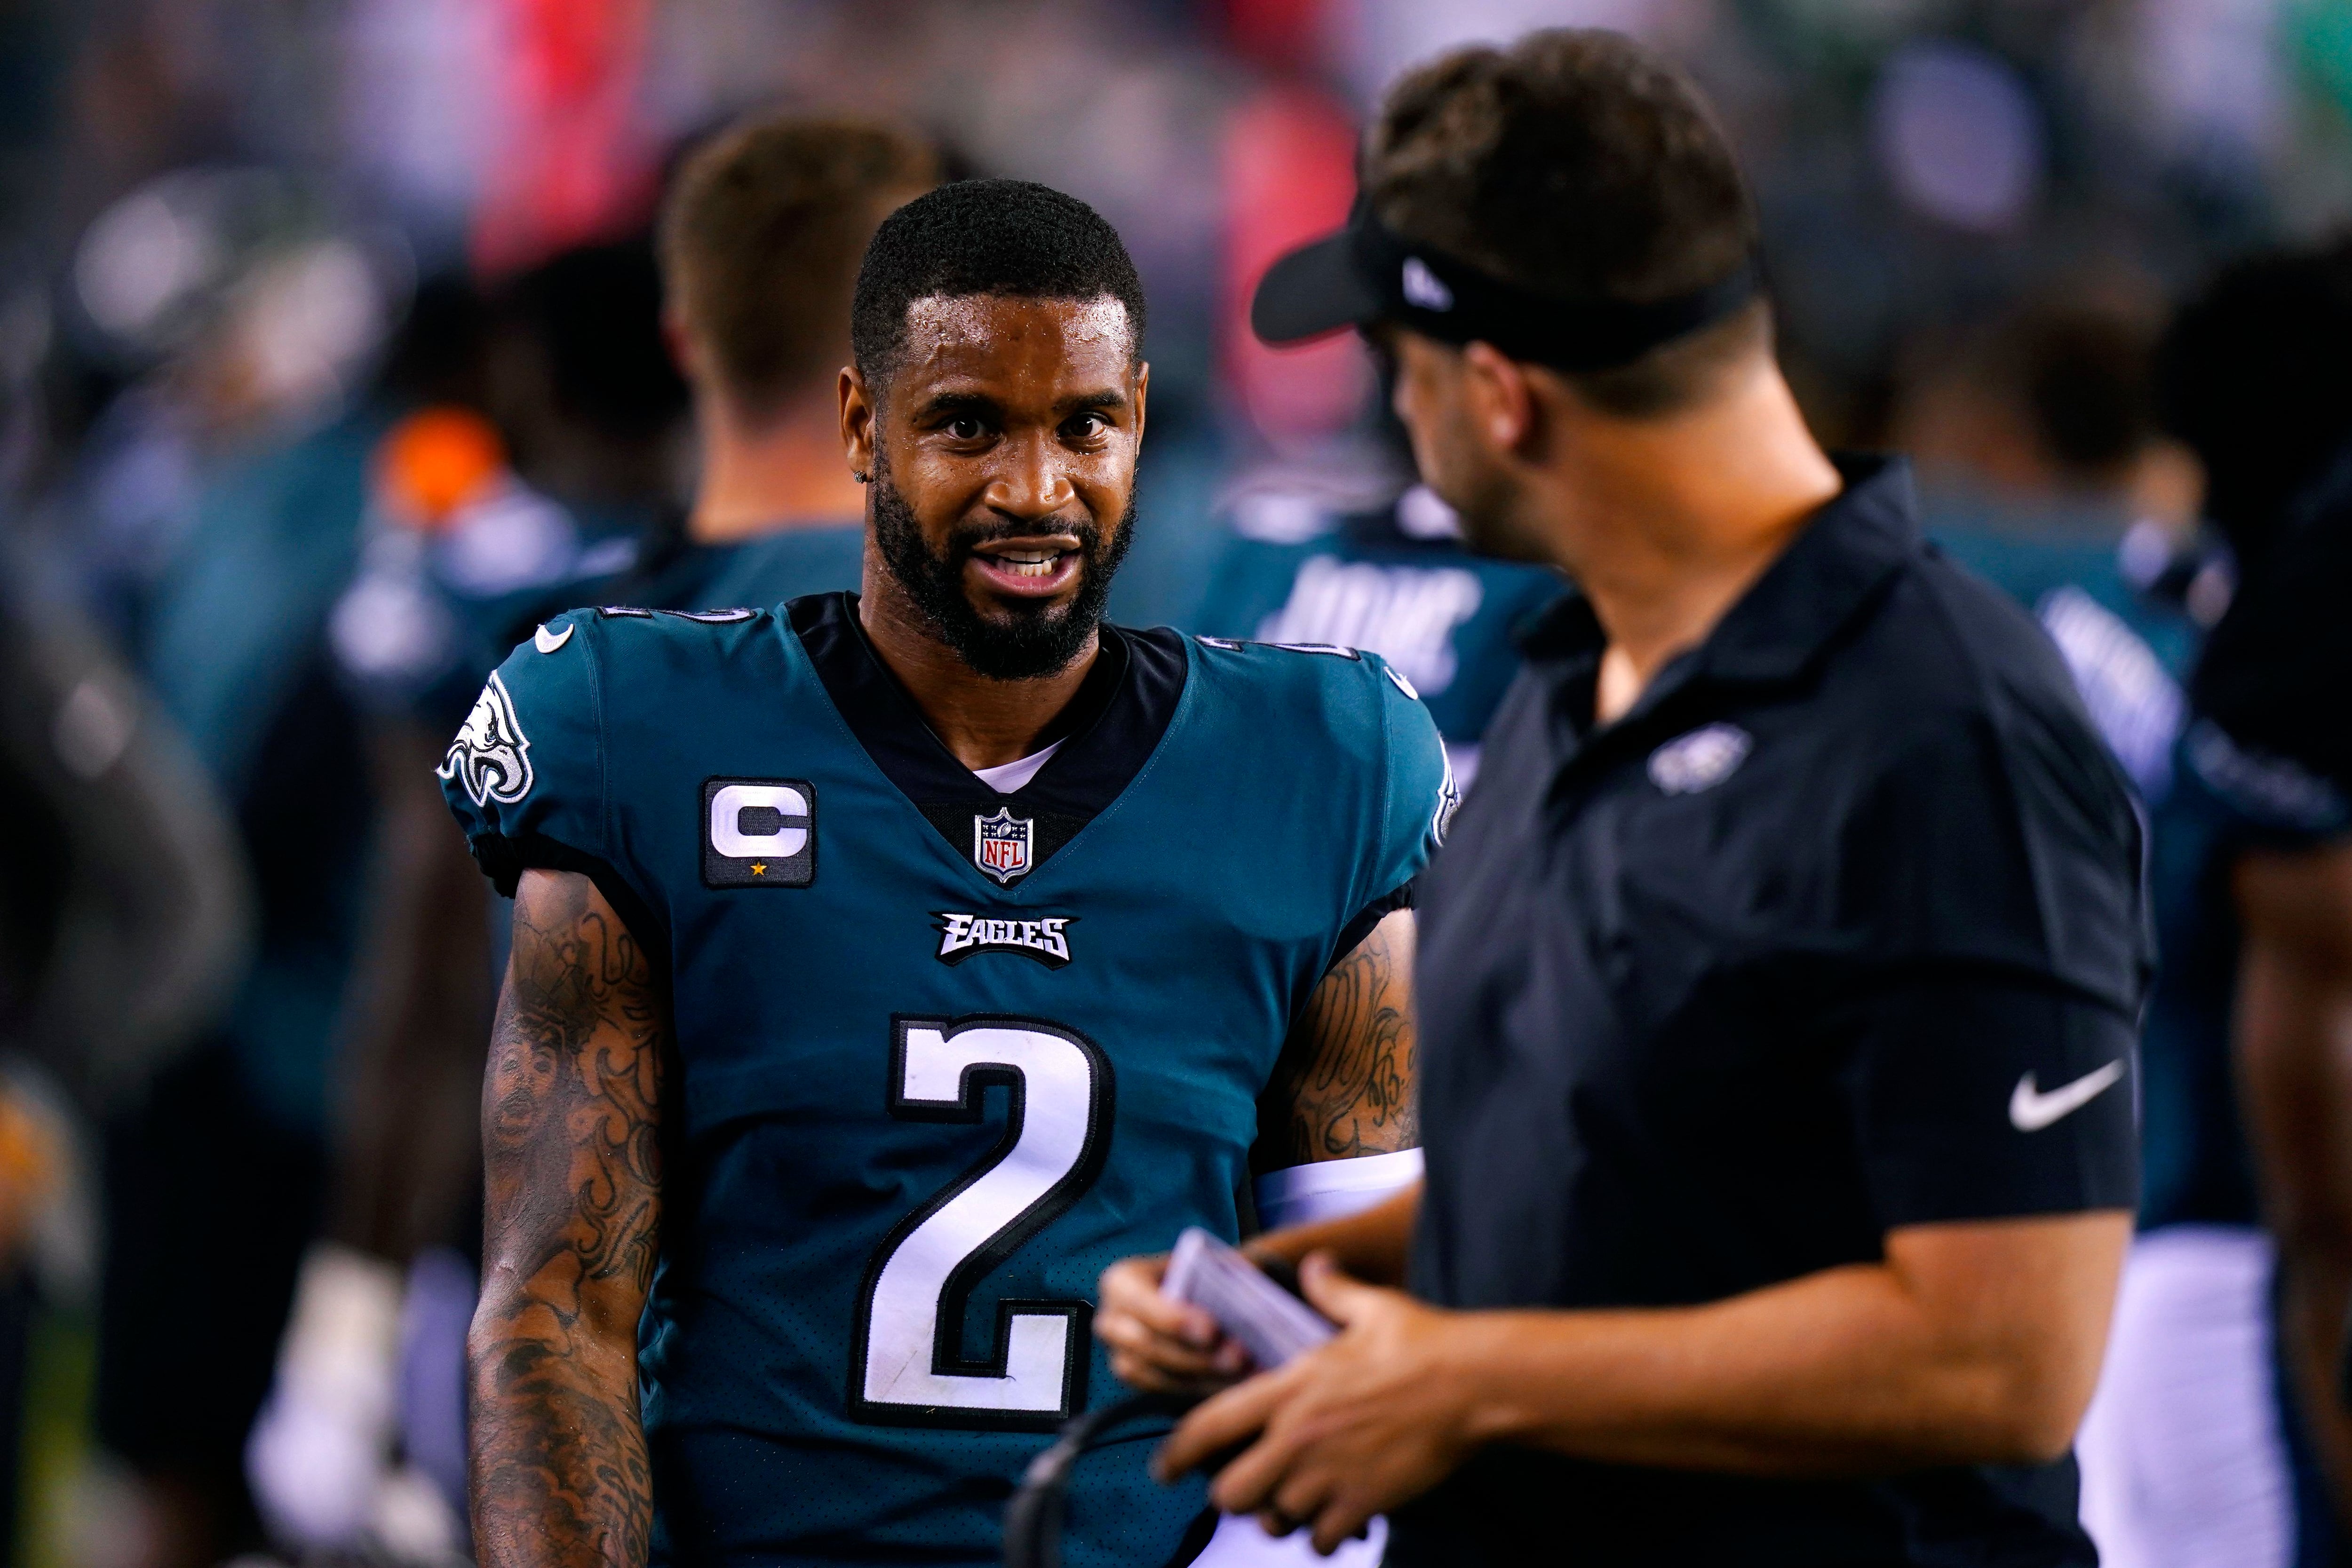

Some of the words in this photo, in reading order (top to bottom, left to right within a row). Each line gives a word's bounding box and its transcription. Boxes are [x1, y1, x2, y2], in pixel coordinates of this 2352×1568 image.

[711, 785, 808, 857] C
[985, 840, 1023, 868] NFL
[941, 913, 1070, 961] EAGLES
[862, 1025, 1094, 1415] 2
